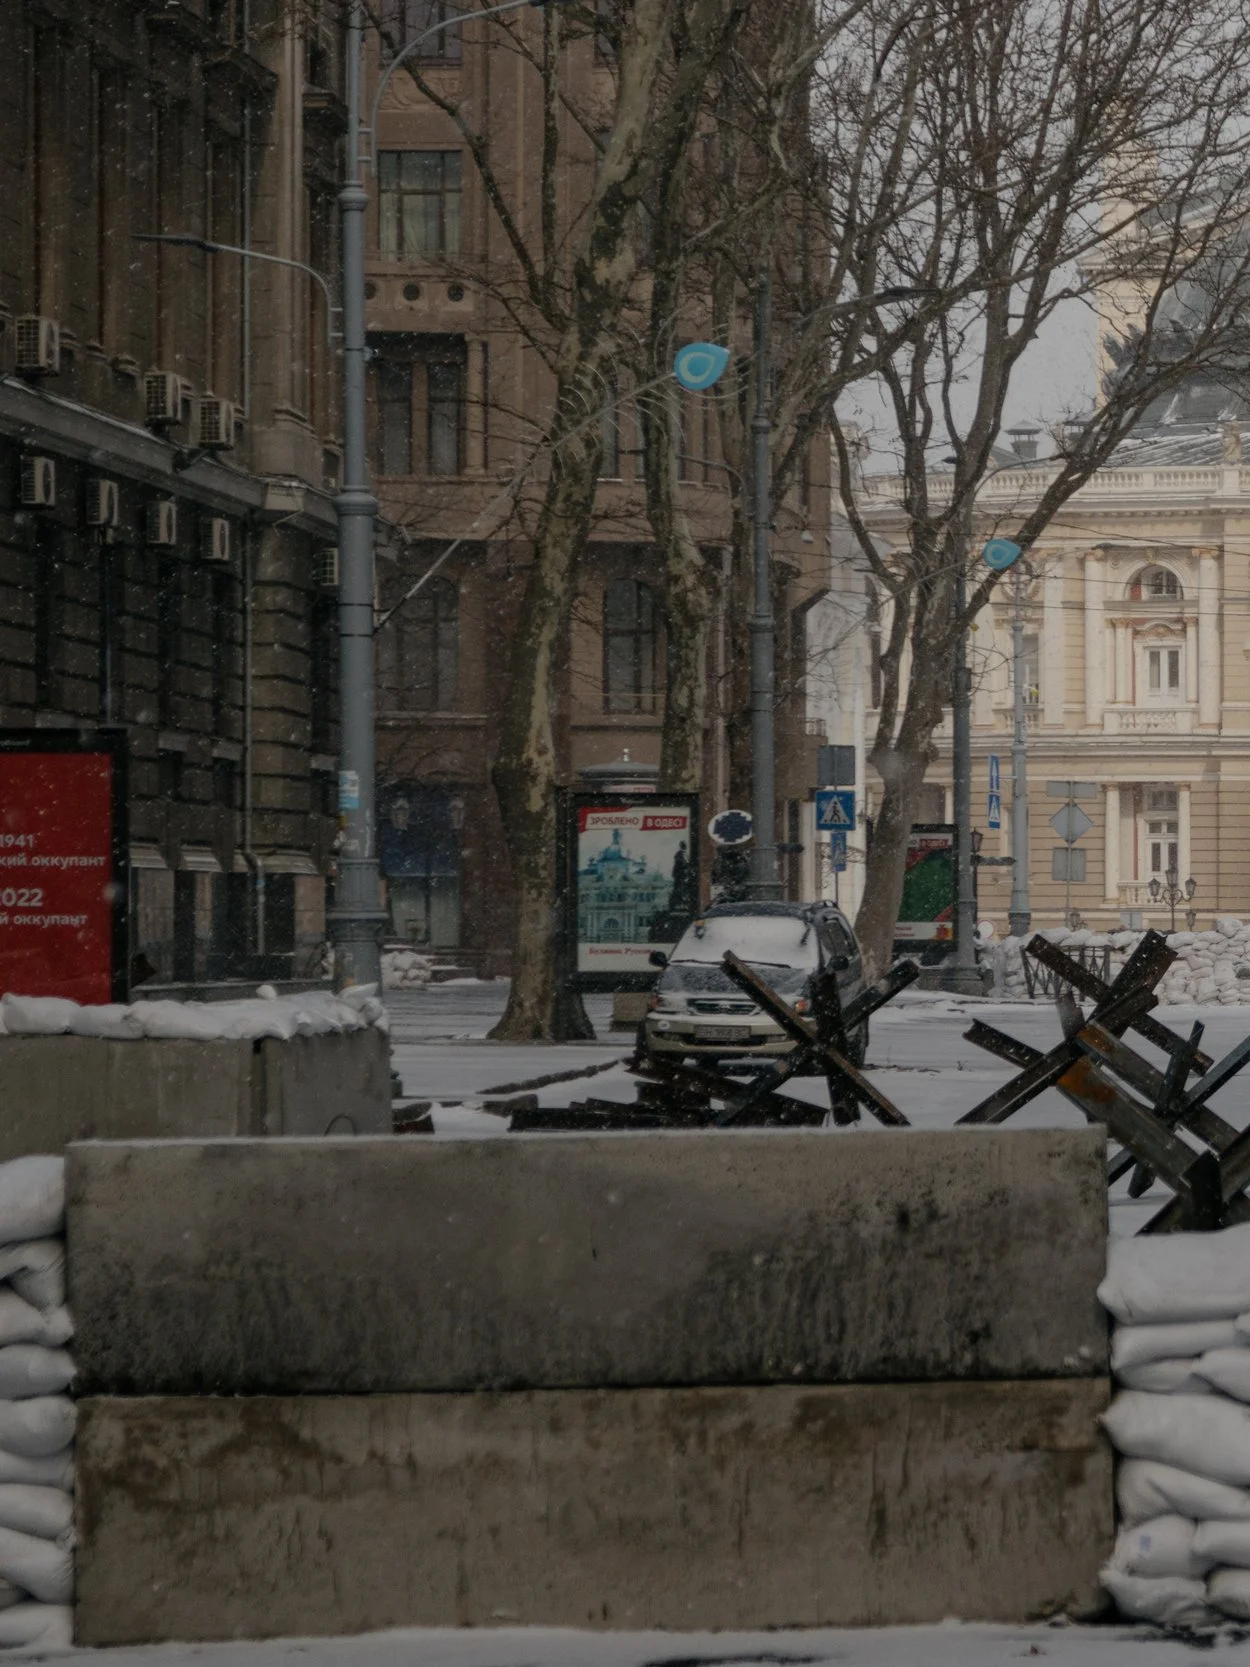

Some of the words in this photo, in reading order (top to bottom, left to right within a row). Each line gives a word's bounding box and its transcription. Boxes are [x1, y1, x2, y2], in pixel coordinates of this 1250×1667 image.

[590, 816, 640, 826] ЗРОБЛЕНО
[646, 818, 652, 827] В
[654, 818, 683, 828] ОДЕСІ
[31, 855, 106, 870] оккупант
[0, 887, 44, 907] 022
[13, 914, 89, 929] оккупант
